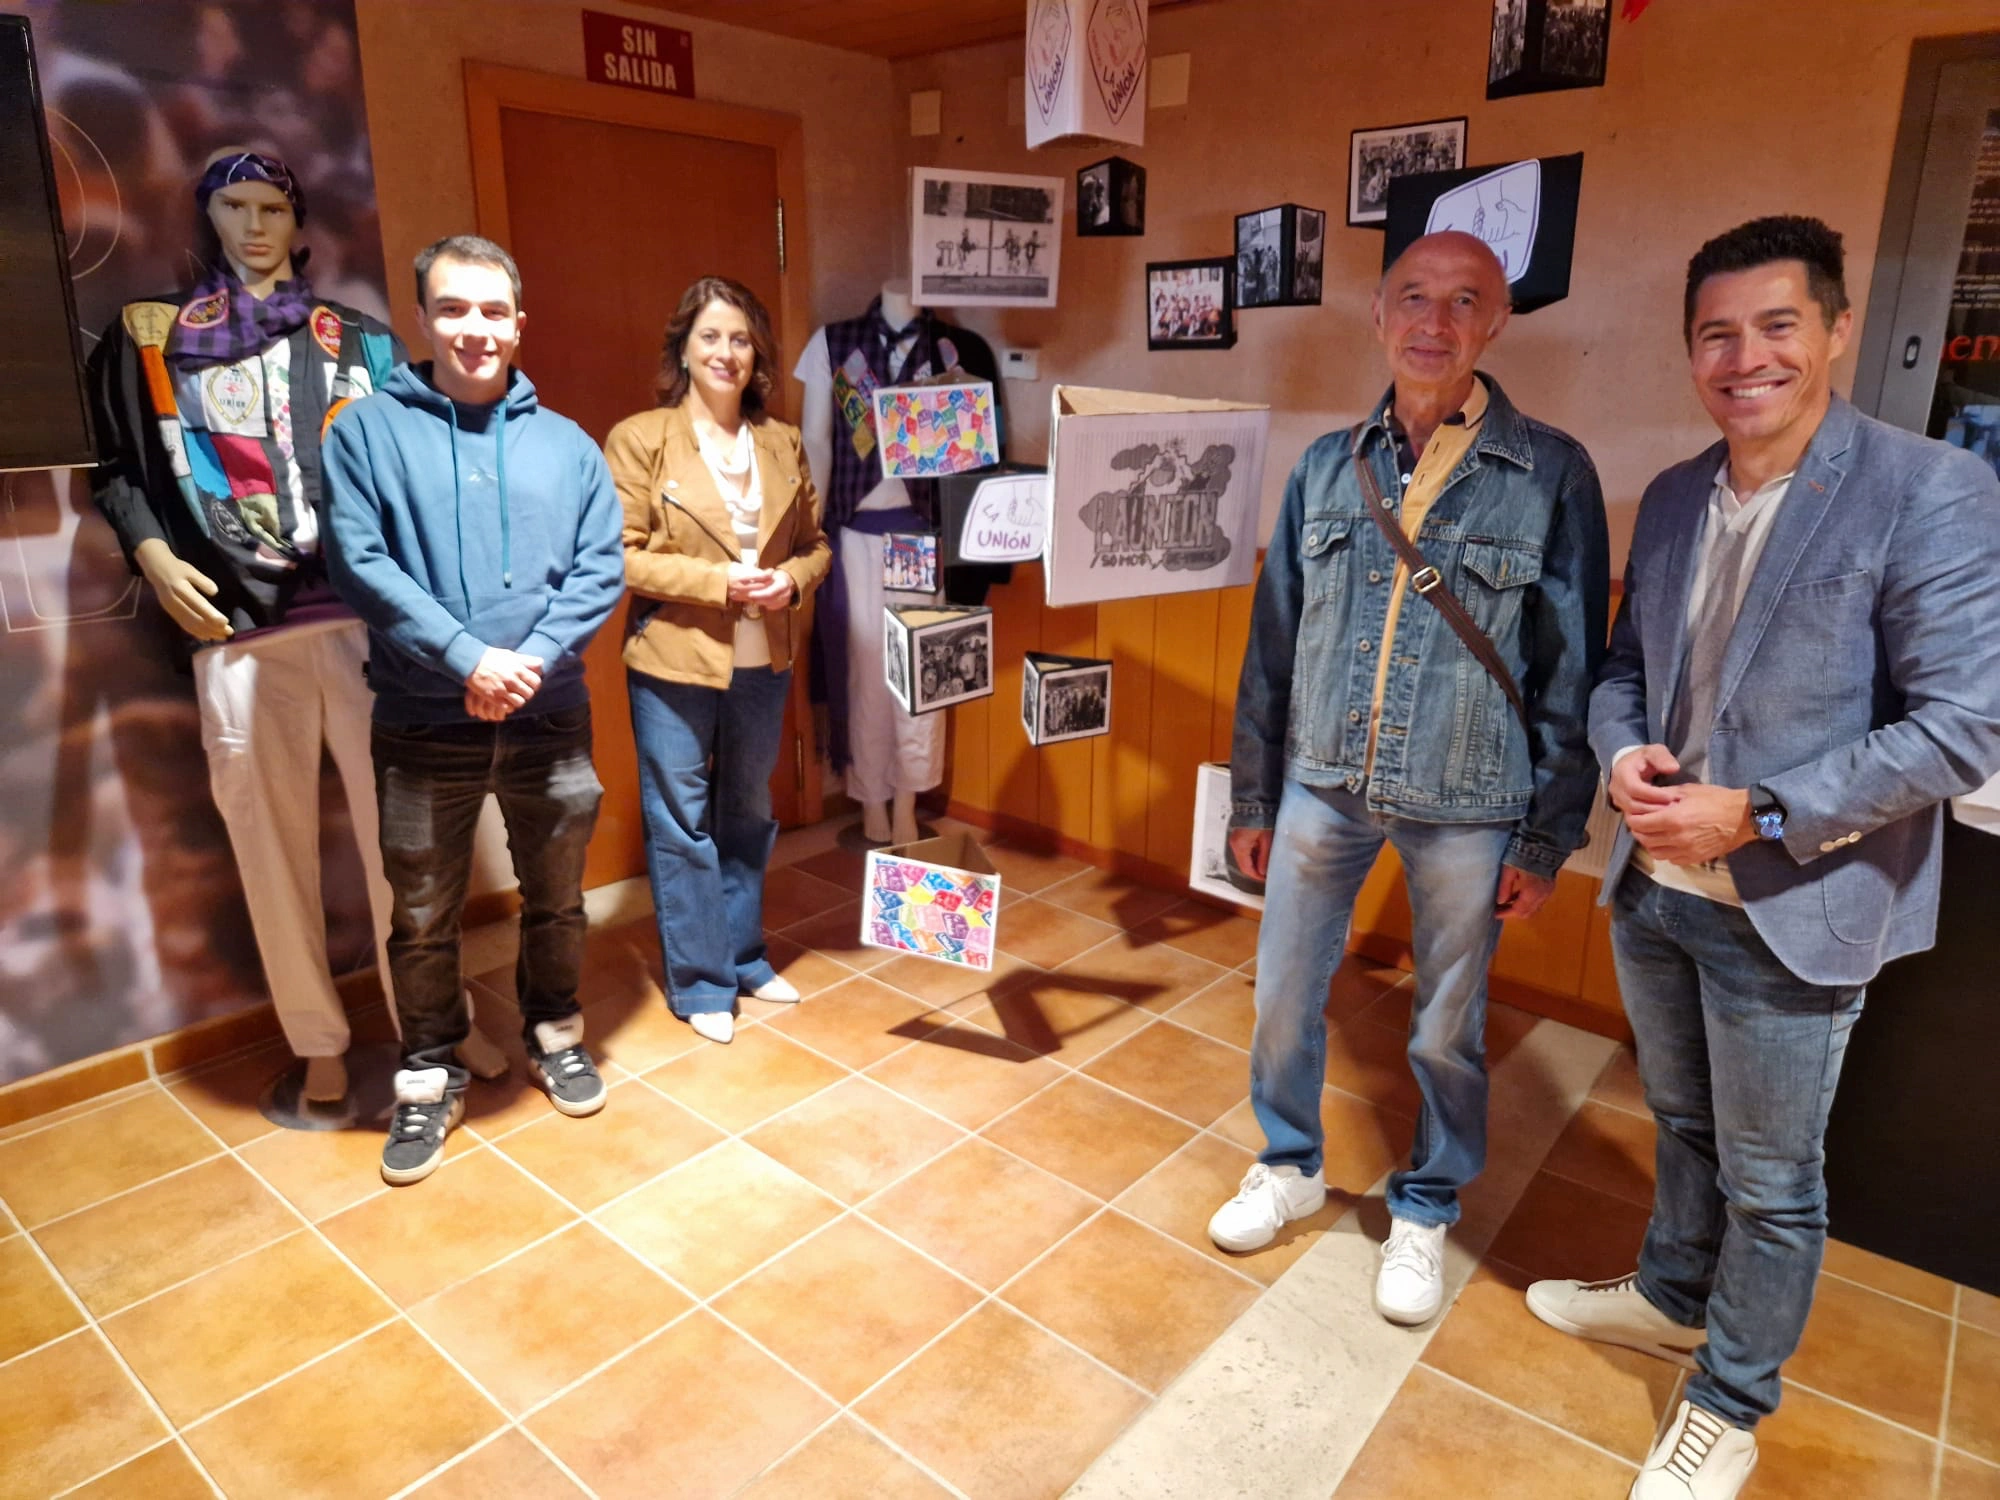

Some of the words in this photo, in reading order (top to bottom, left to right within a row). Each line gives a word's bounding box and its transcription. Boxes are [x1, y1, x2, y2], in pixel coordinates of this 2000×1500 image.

[621, 25, 657, 58] SIN
[604, 51, 677, 90] SALIDA
[1103, 65, 1115, 88] LA
[983, 503, 1000, 522] LA
[977, 529, 1031, 550] UNIÓN
